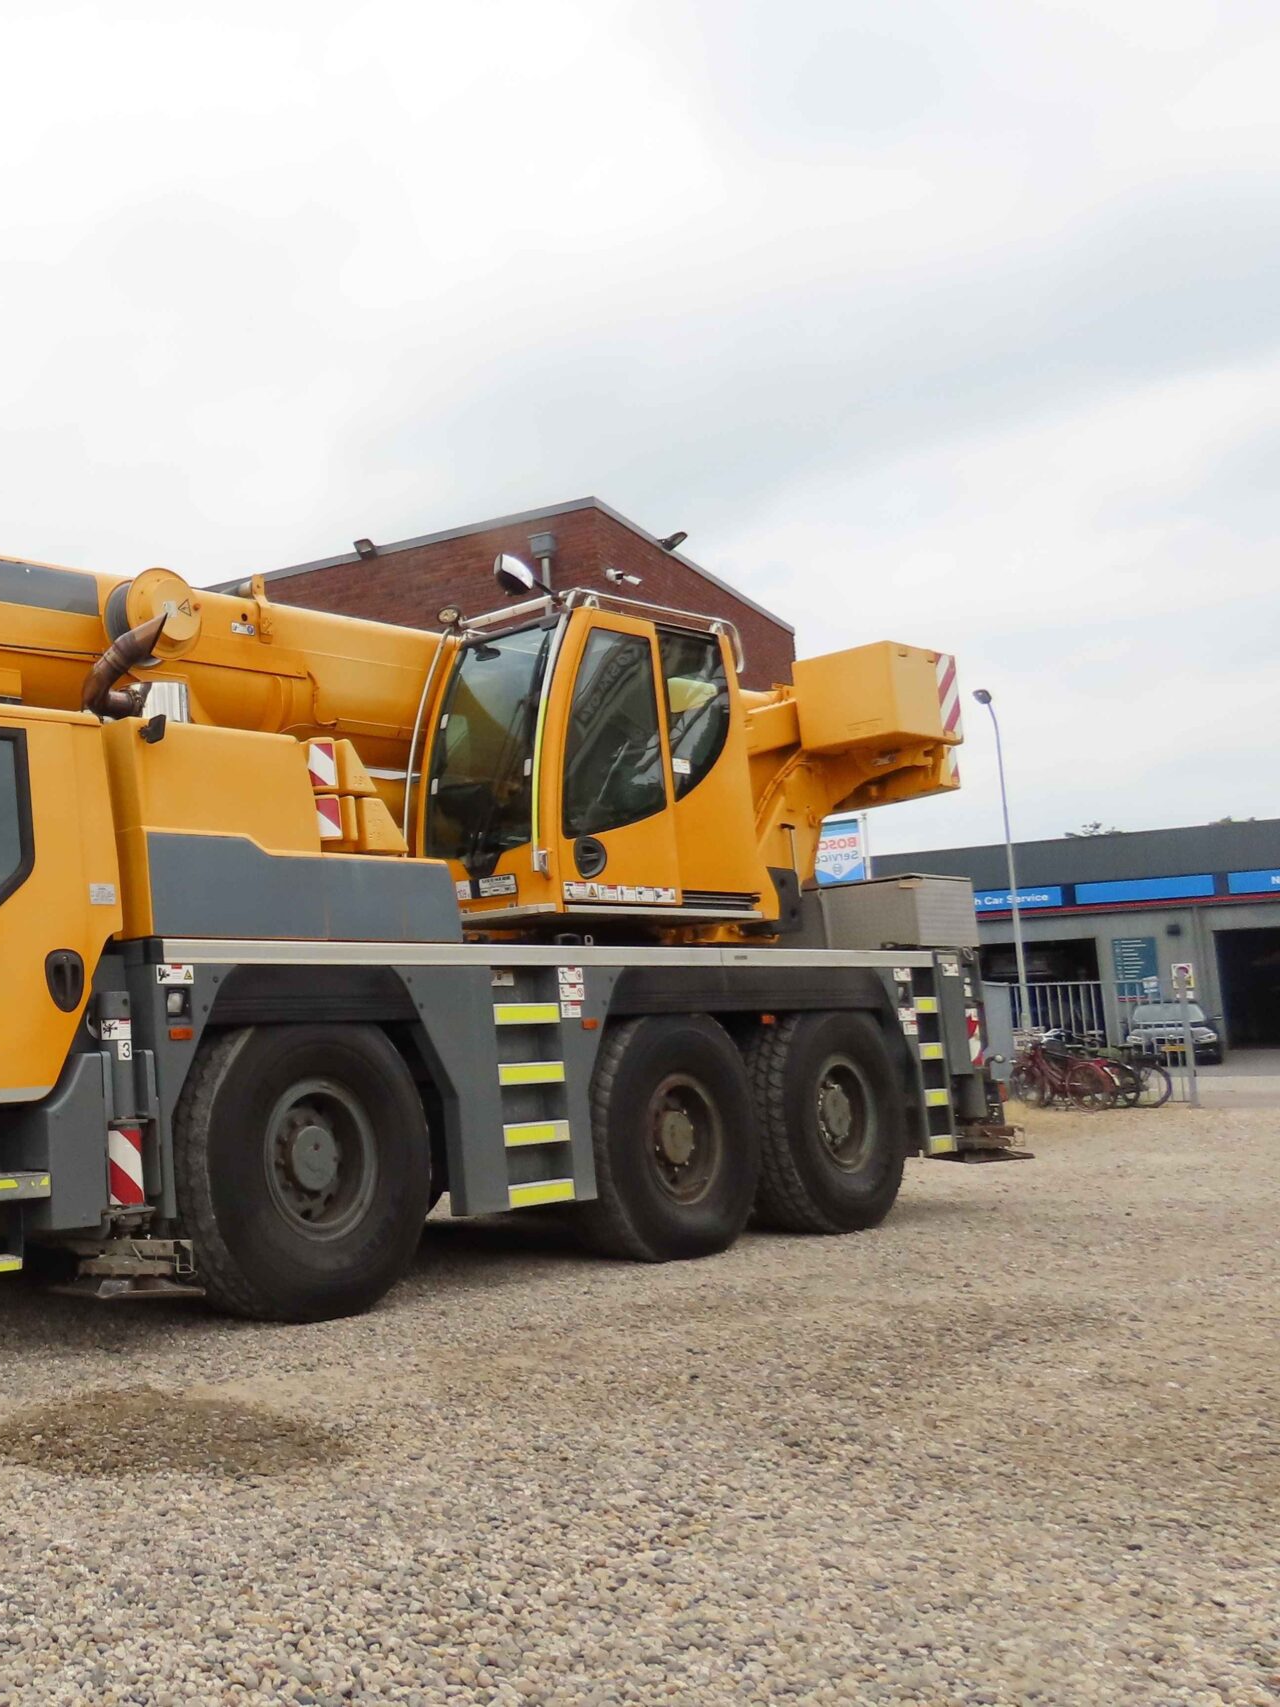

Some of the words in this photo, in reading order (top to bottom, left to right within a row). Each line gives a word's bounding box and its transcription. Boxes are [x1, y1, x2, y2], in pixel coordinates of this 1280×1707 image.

[984, 896, 1003, 905] Car
[1006, 894, 1049, 904] Service
[122, 1042, 131, 1058] 3
